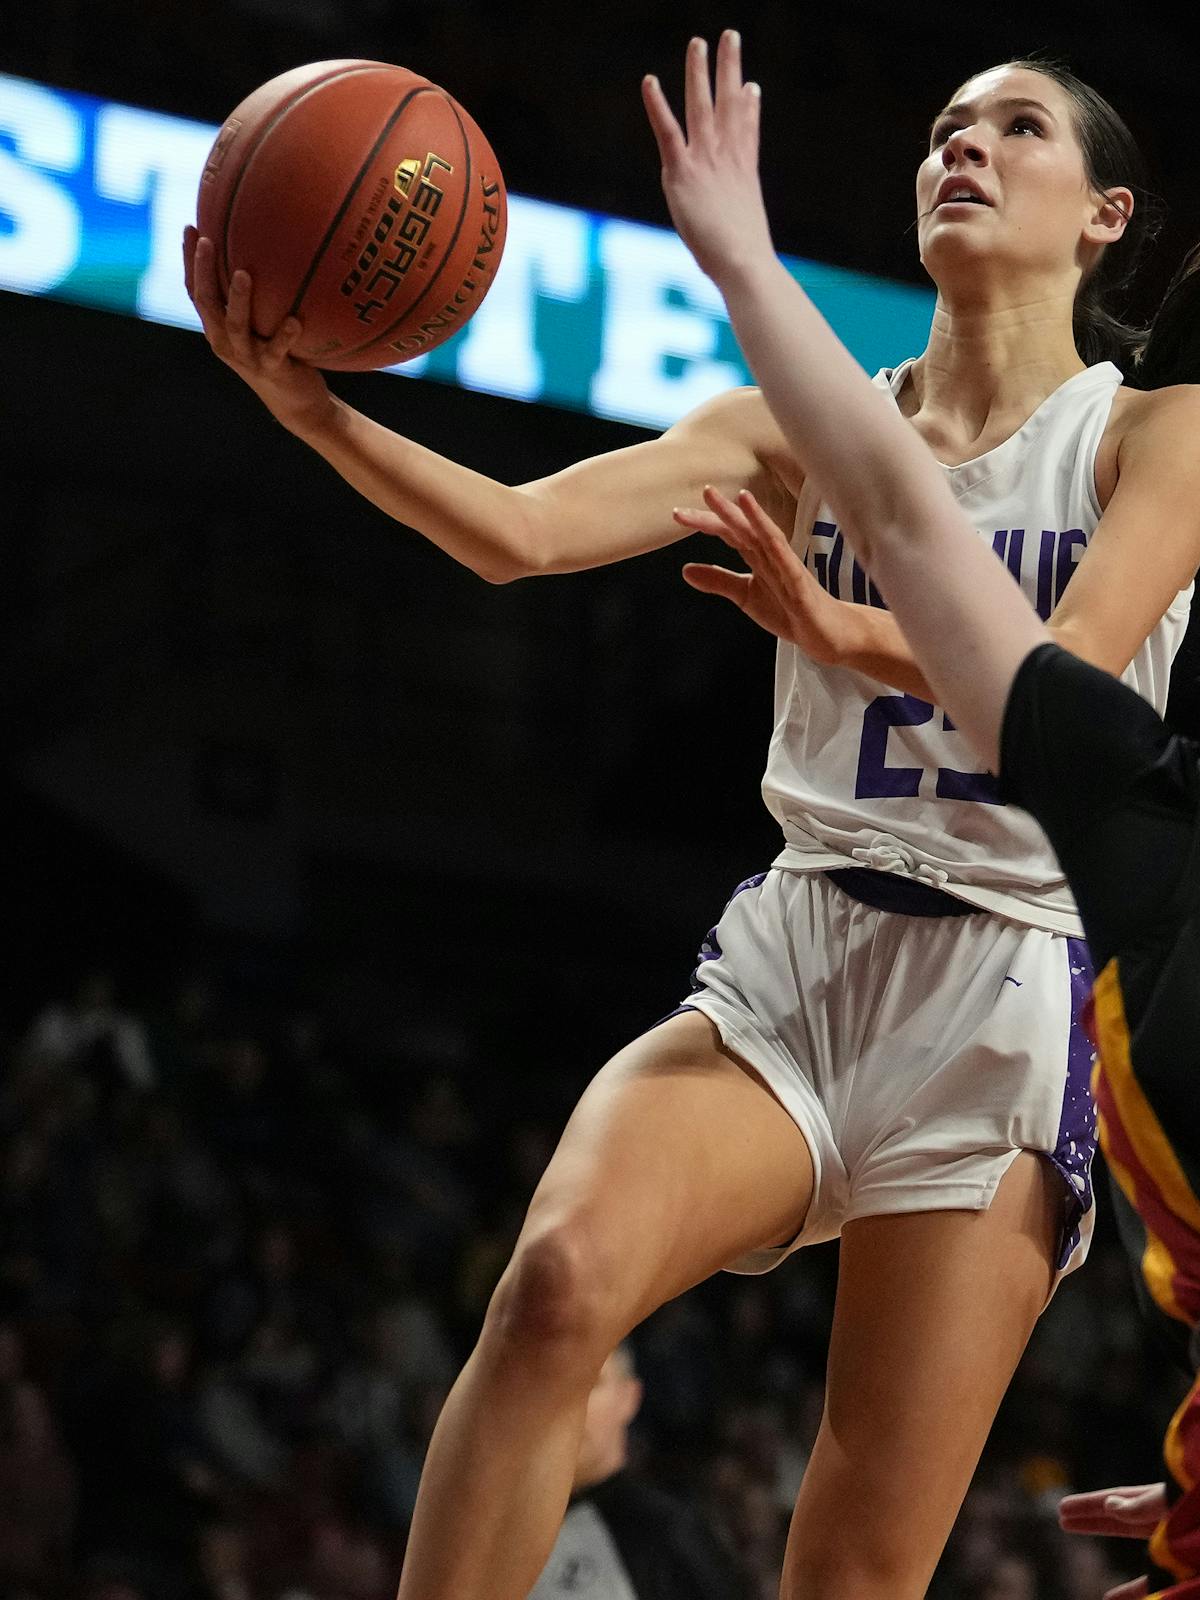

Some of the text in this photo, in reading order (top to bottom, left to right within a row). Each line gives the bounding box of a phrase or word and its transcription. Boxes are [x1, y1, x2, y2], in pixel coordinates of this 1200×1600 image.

[0, 74, 755, 430] STTE
[353, 152, 453, 325] LEGACY
[388, 175, 501, 353] SPALDING
